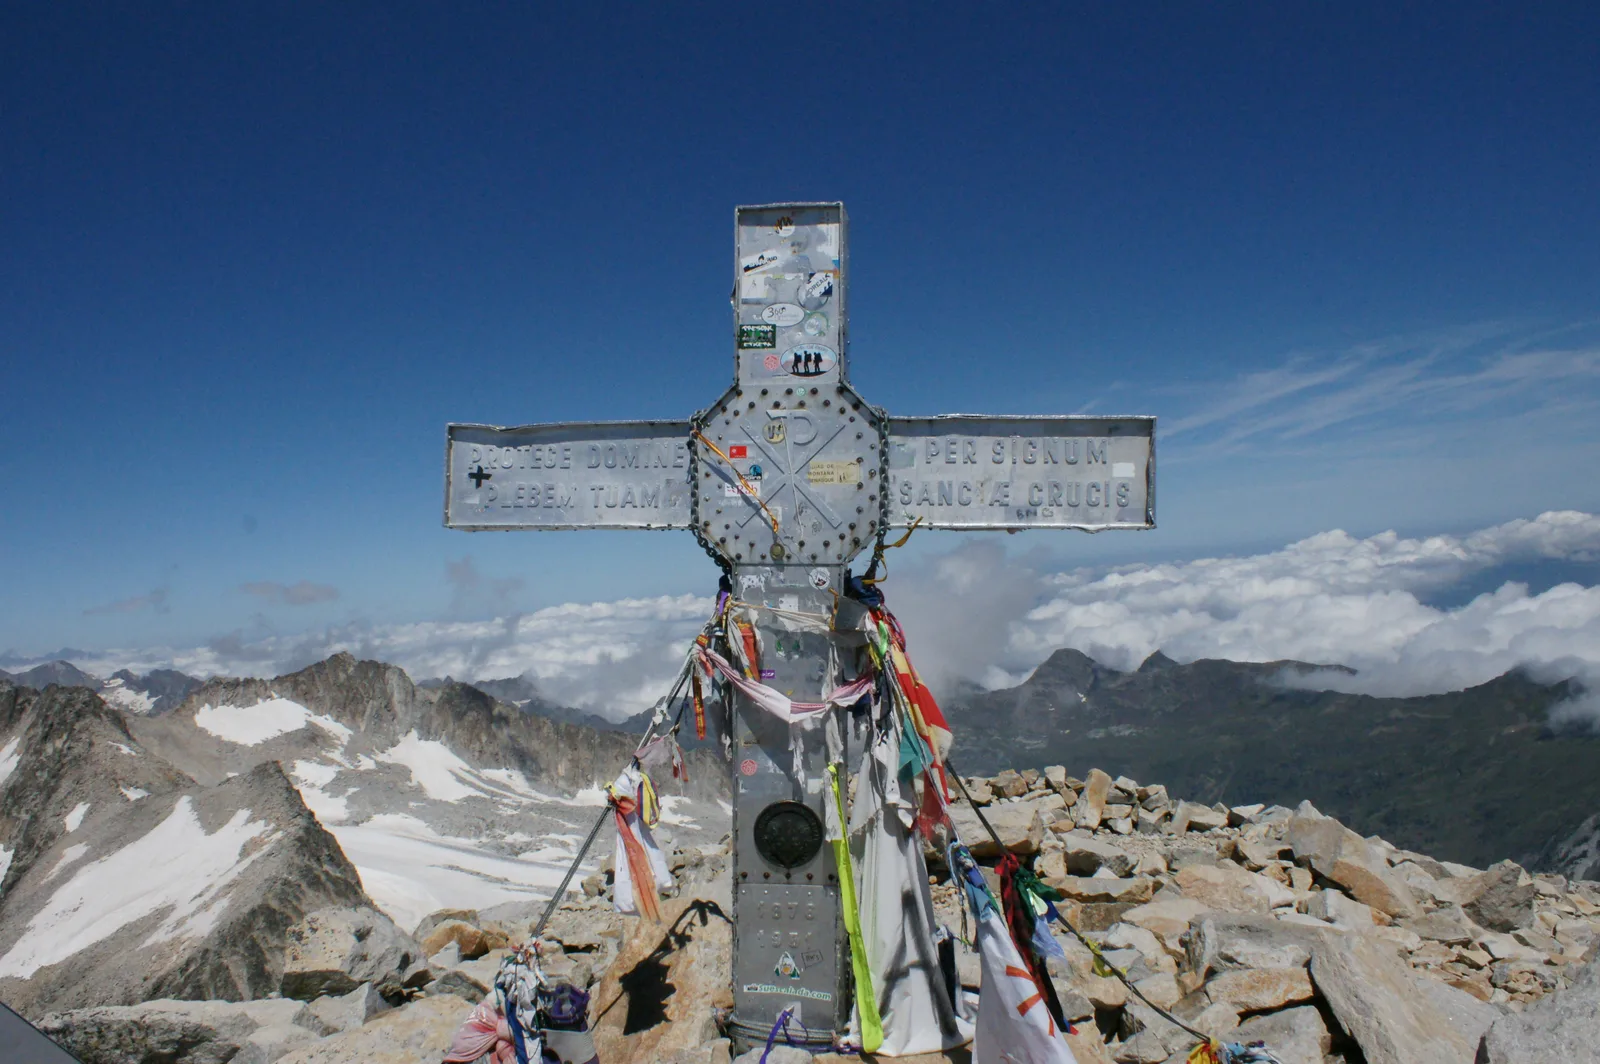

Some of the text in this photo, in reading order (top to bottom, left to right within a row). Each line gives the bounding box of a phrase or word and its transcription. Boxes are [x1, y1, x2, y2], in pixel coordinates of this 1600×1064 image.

[469, 441, 685, 470] PROTEGE DOMINE
[924, 437, 1109, 466] PER SIGNUM
[483, 481, 660, 509] PLEBEM TUAM
[1028, 480, 1130, 508] CRUCIS
